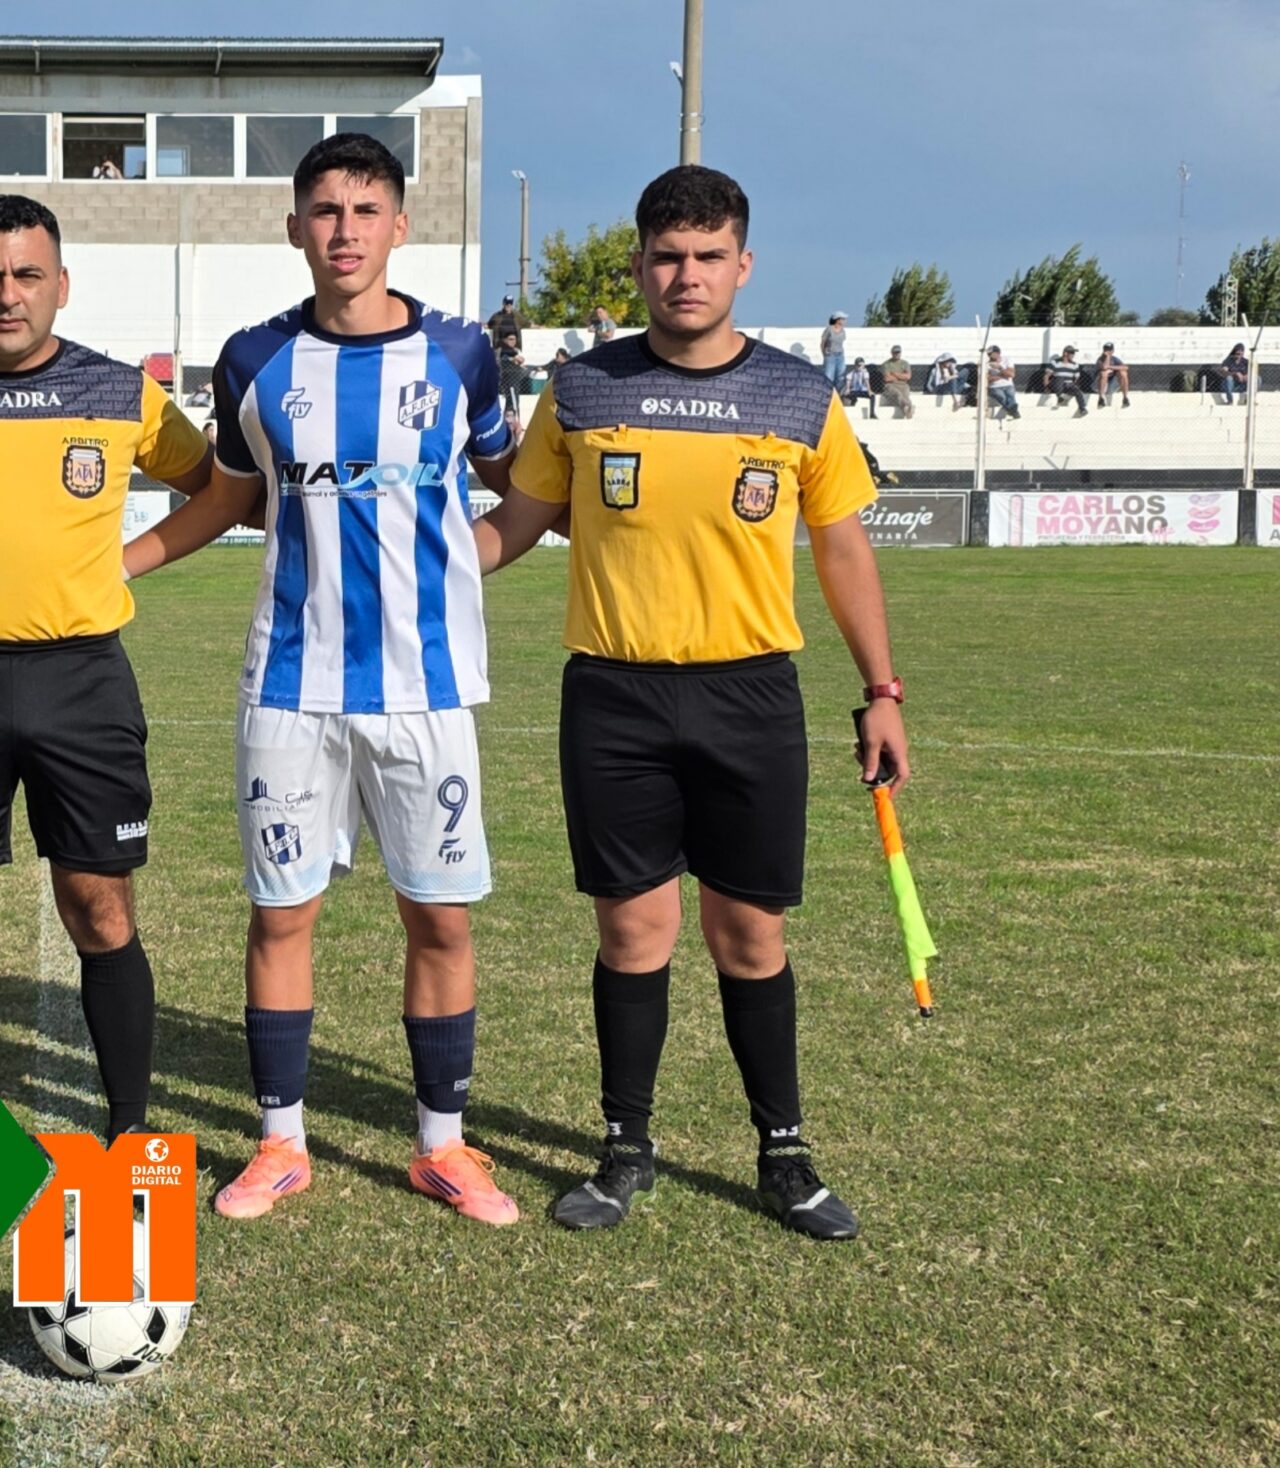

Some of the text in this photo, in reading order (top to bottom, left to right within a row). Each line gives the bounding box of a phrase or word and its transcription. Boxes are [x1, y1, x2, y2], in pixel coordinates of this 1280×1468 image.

[658, 398, 740, 420] SADRA
[62, 437, 109, 447] ARBITRO
[739, 456, 786, 469] ARBITRO
[280, 461, 444, 487] MATOIL
[1038, 495, 1166, 515] CARLOS
[1036, 516, 1168, 535] MOYANO
[437, 775, 469, 832] 9
